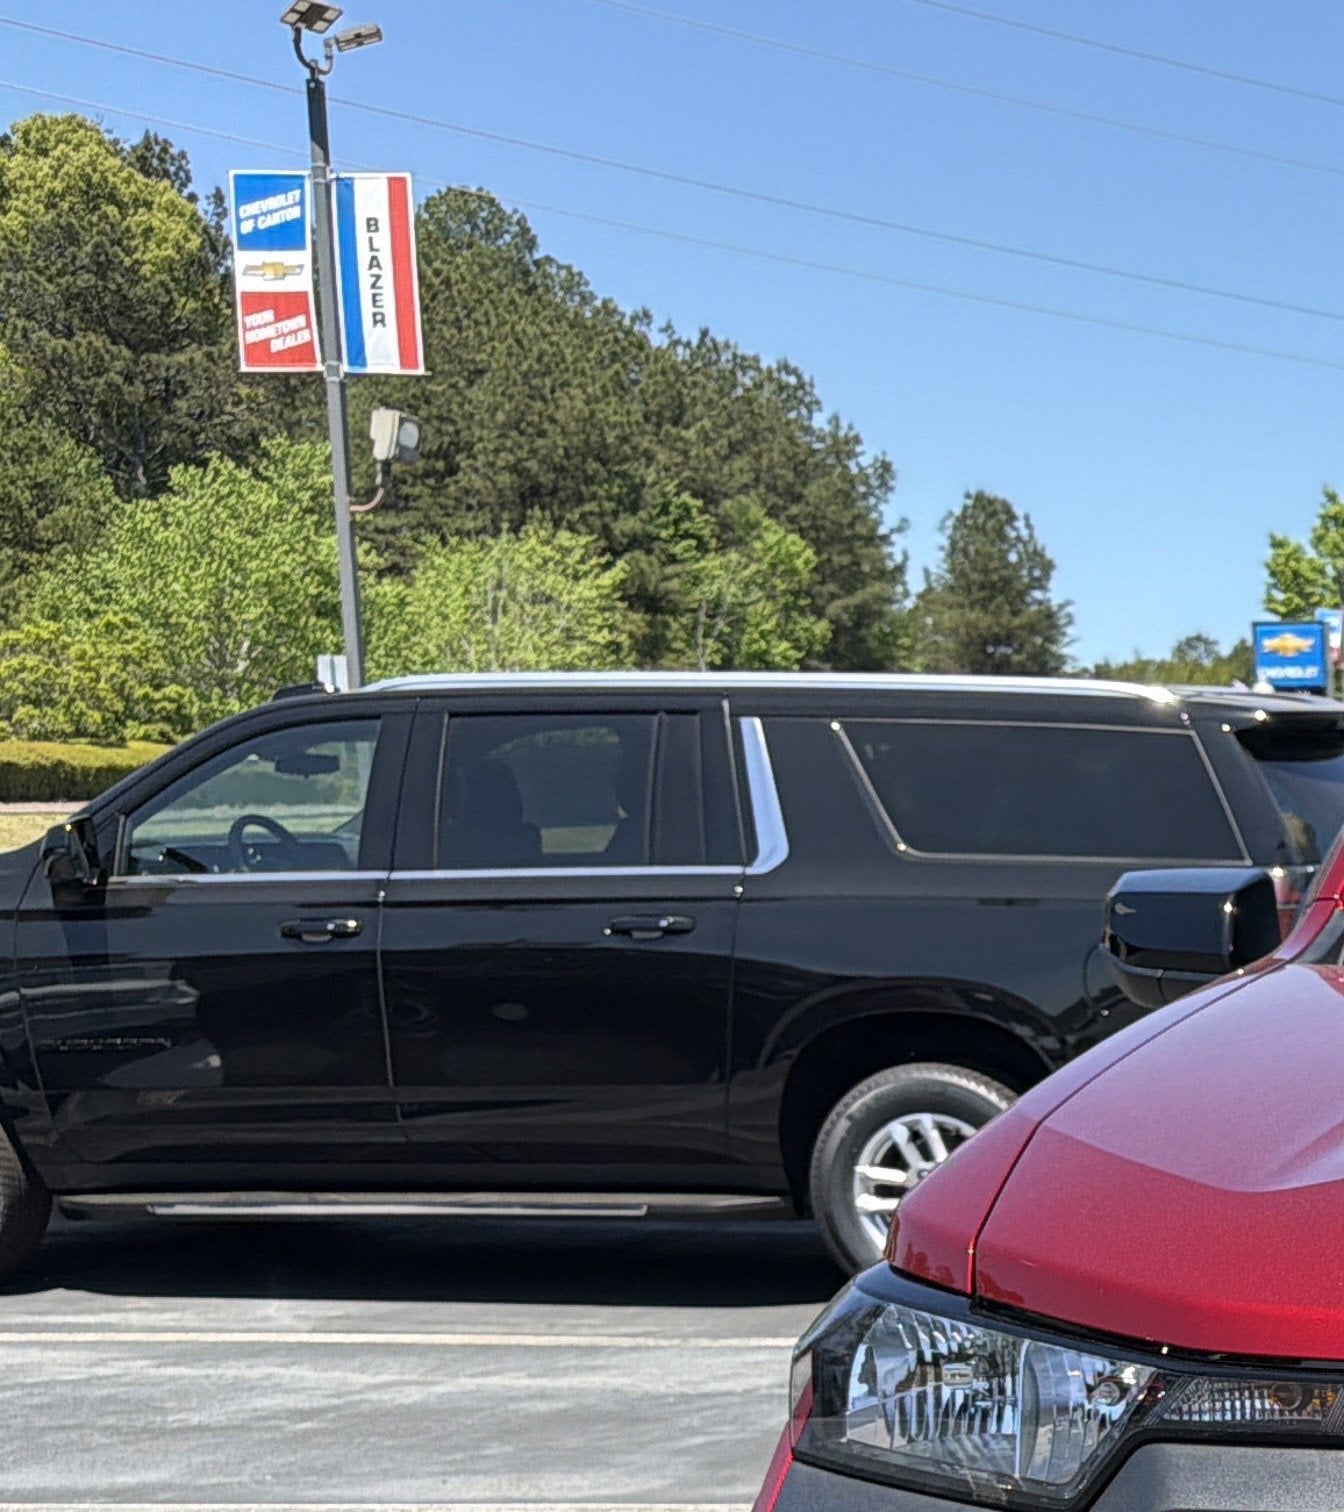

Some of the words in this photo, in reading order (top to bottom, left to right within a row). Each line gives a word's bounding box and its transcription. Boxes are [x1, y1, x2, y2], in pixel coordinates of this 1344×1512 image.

[239, 189, 302, 219] CHEVROLET
[240, 219, 255, 235] OF
[257, 206, 301, 230] CANTON
[365, 216, 387, 329] BLAZER
